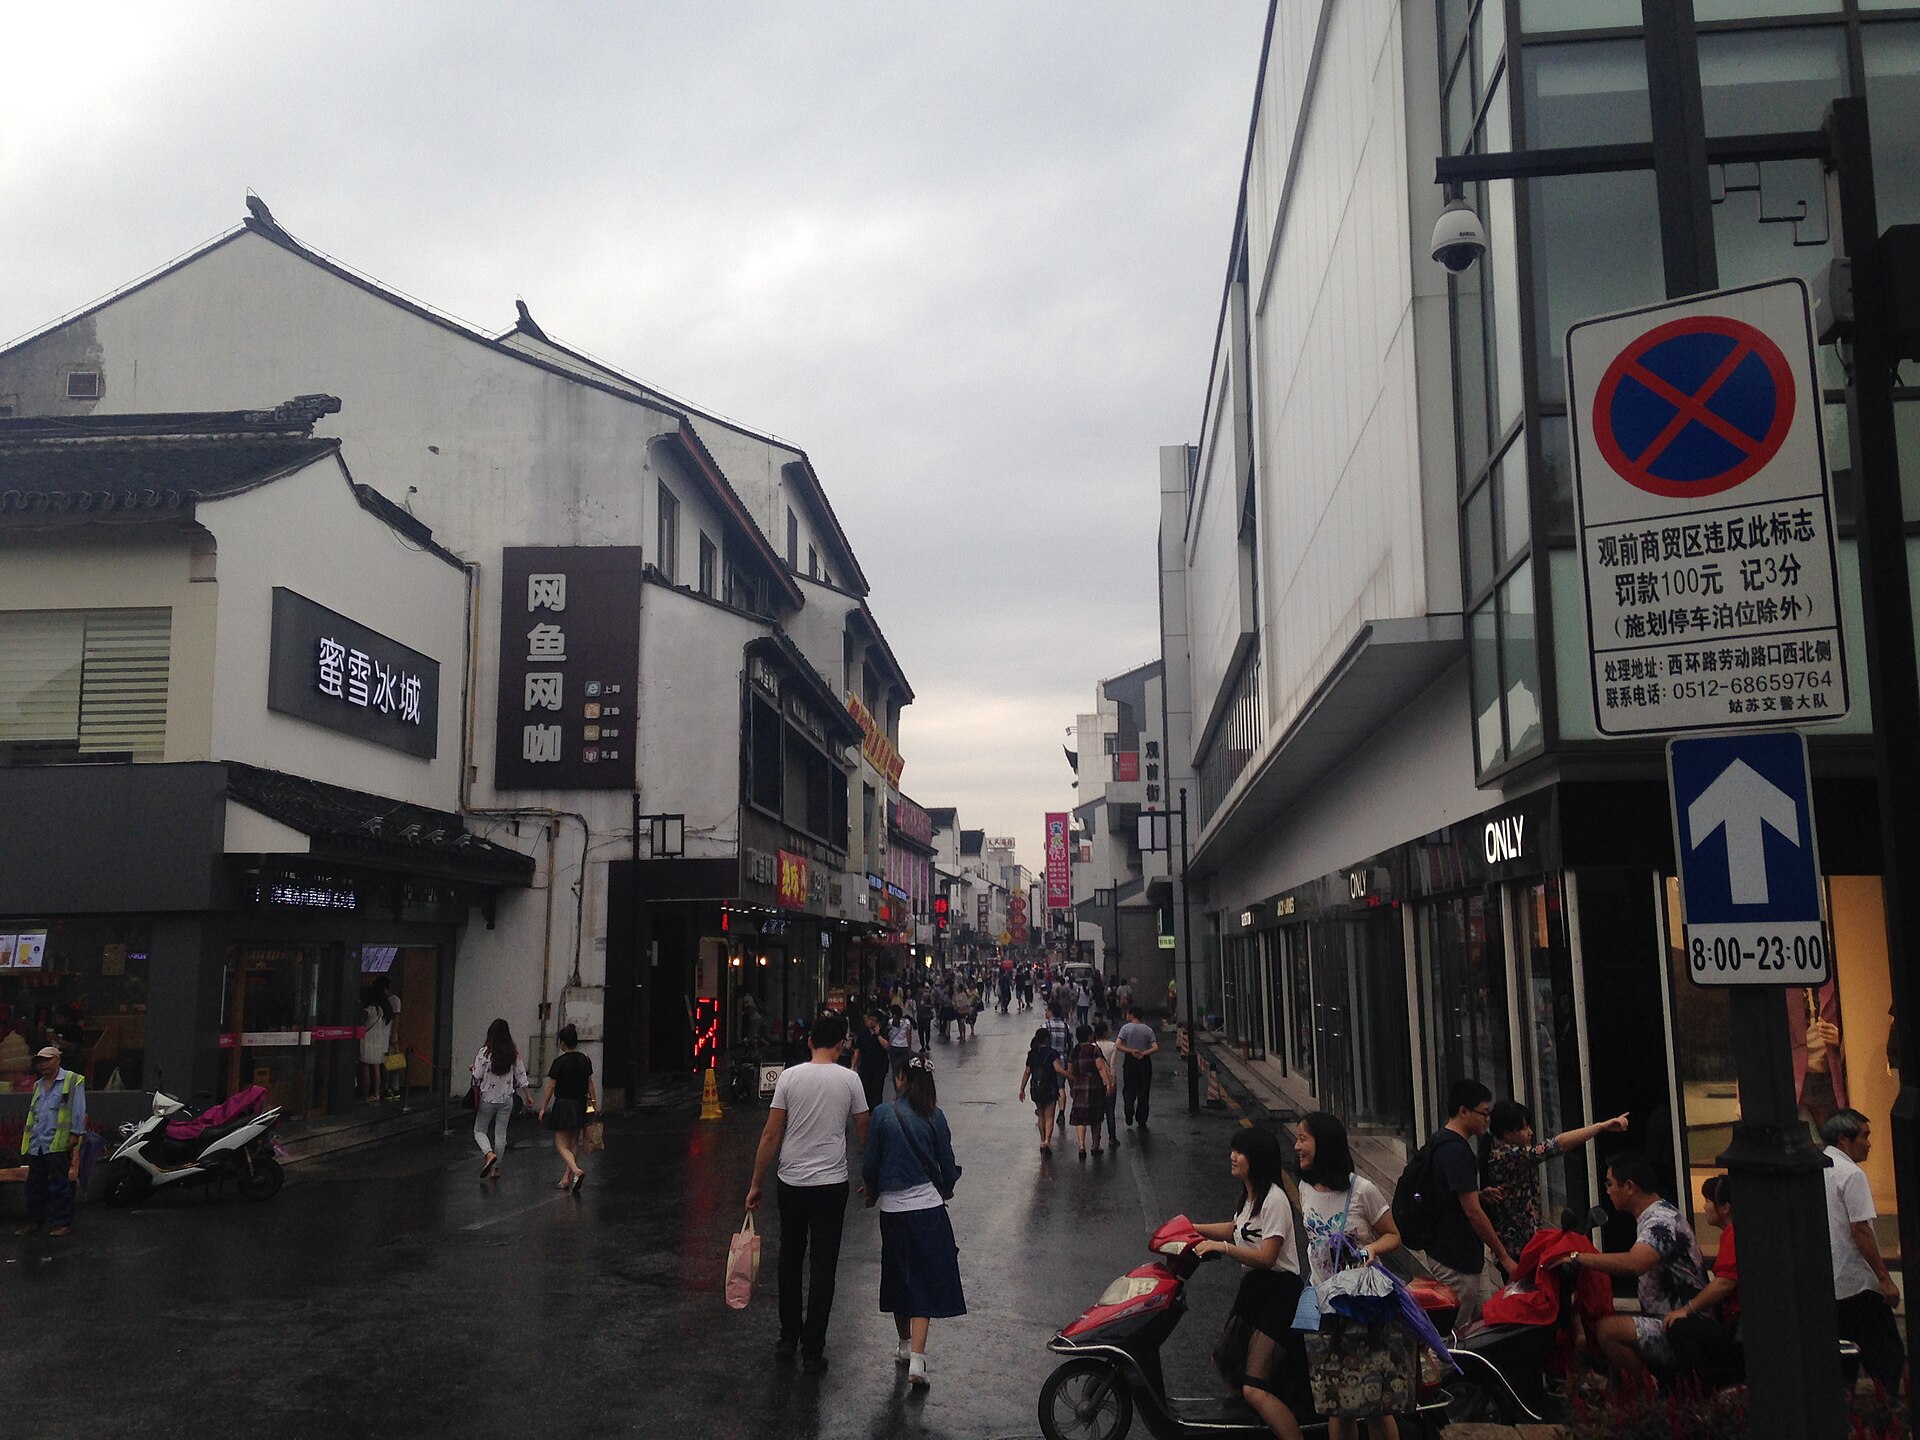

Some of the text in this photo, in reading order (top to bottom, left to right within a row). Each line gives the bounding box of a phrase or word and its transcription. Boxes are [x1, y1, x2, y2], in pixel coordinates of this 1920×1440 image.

[1597, 508, 1815, 567] 观前商贸区违反此标志
[1615, 553, 1802, 608] 罚款100元 记3分
[1613, 594, 1814, 640] （施划停车泊位除外）
[319, 637, 421, 725] 蜜雪冰城
[522, 573, 567, 763] 网鱼网咖
[1728, 695, 1829, 714] 姑苏交警大队
[1484, 814, 1525, 864] ONLY
[1349, 870, 1368, 900] ONLY
[1692, 935, 1823, 972] 8:00-23:00
